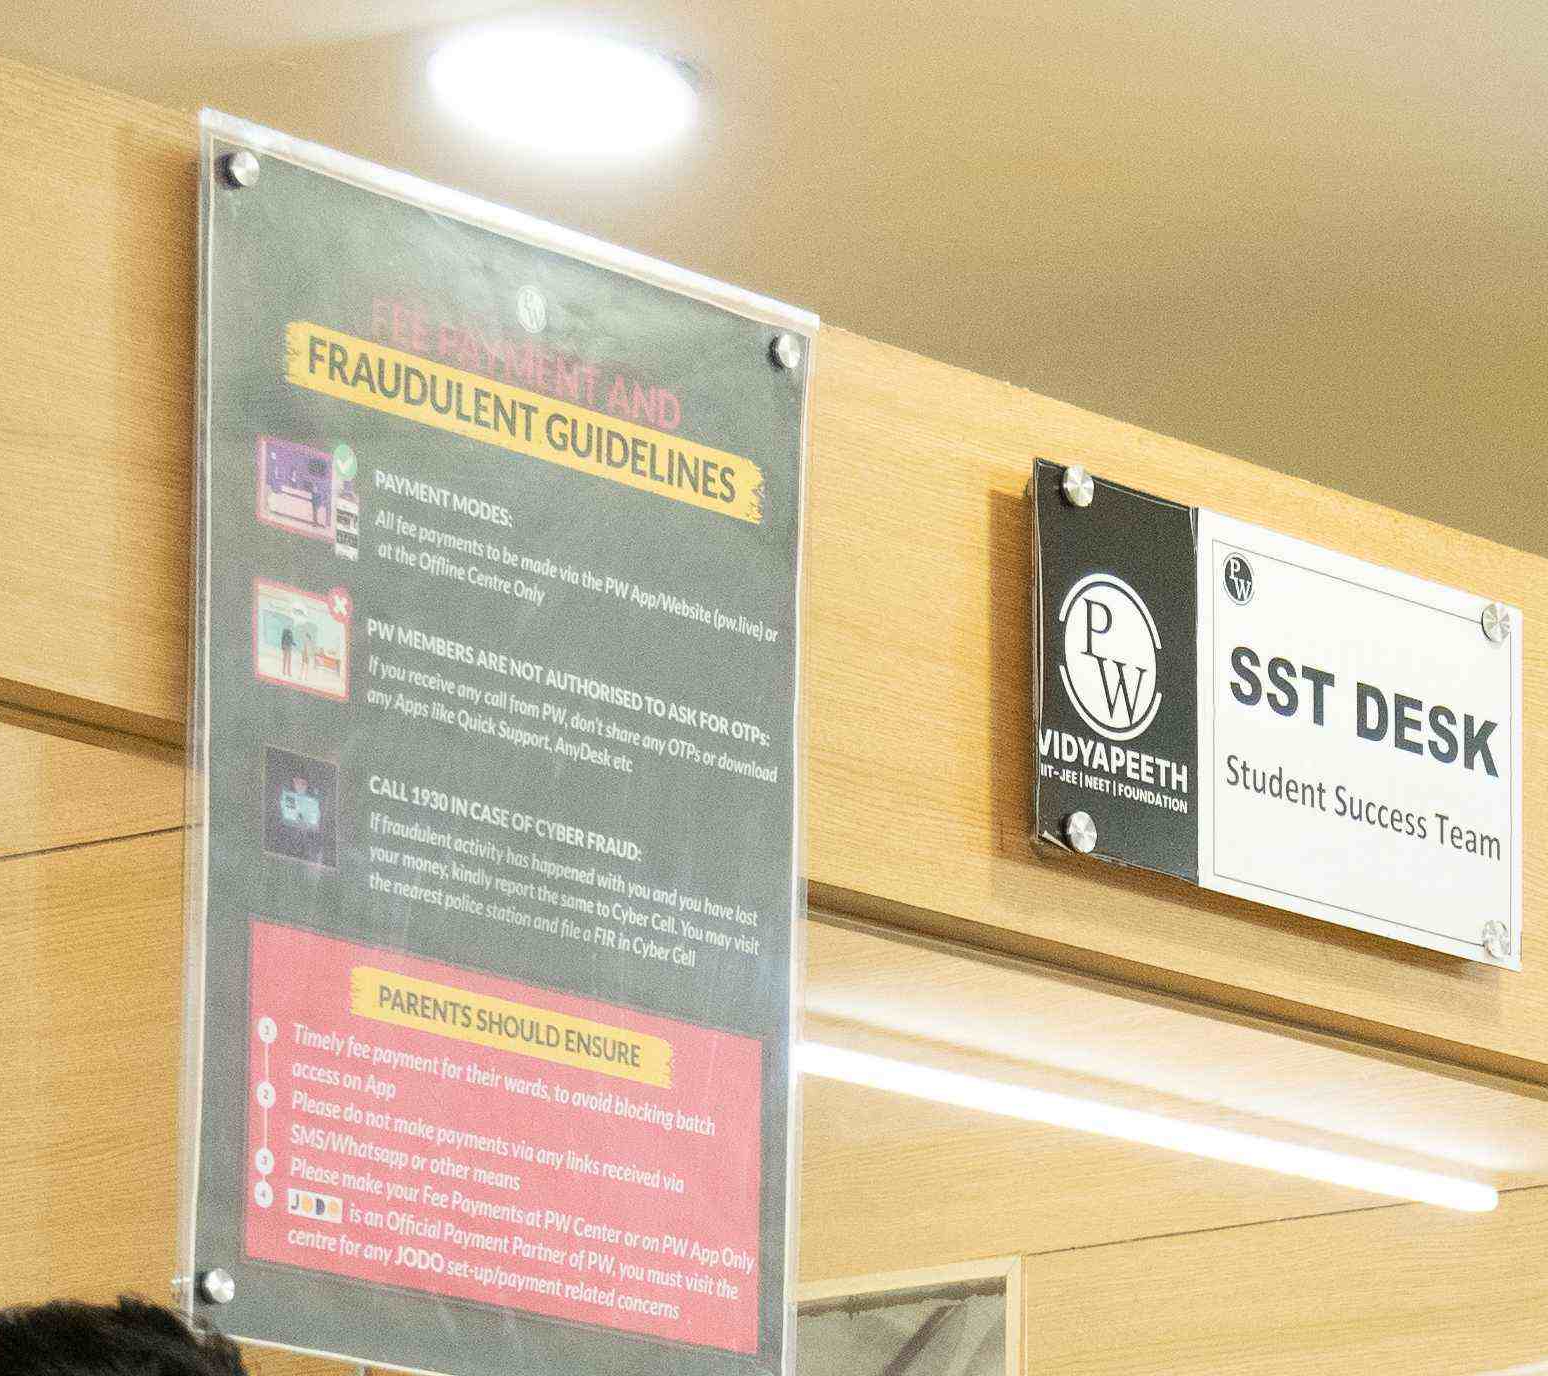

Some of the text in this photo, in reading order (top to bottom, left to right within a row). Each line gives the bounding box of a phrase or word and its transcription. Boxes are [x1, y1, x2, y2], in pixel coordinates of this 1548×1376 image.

[307, 333, 738, 504] FRAUDULENT GUIDELINES
[606, 374, 683, 431] AND
[375, 469, 514, 528] PAYMENT MODES:
[374, 509, 394, 530] All
[396, 515, 417, 538] fee
[418, 525, 485, 558] payments
[486, 542, 500, 562] to
[502, 546, 519, 566] be
[520, 556, 557, 579] made
[559, 565, 579, 585] via
[581, 570, 603, 592] the
[605, 576, 630, 599] PW
[630, 584, 712, 625] App/Website
[765, 627, 779, 643] or
[378, 542, 546, 607] at the Offline Centre Only
[1228, 557, 1253, 602] PW
[367, 618, 771, 748] PW MEMBERS ARE NOT AUTHORISED TO ASK FOR OTPs:
[1229, 645, 1499, 778] SST DESK
[1038, 728, 1189, 793] VIDYAPEETH
[1040, 764, 1189, 814] IIT-JEE NEET FOUNDATION
[369, 775, 642, 862] CALL 1930 IN CASE OF CYBER FRAUD:
[1226, 753, 1501, 861] Student Success Team
[379, 984, 641, 1068] PARENTS SHOULD ENSURE
[291, 1063, 397, 1101] access on App
[290, 1123, 521, 1193] SMS/Whatsapp or other means
[287, 1228, 680, 1320] centre for any JODO set-up/payment related concerns
